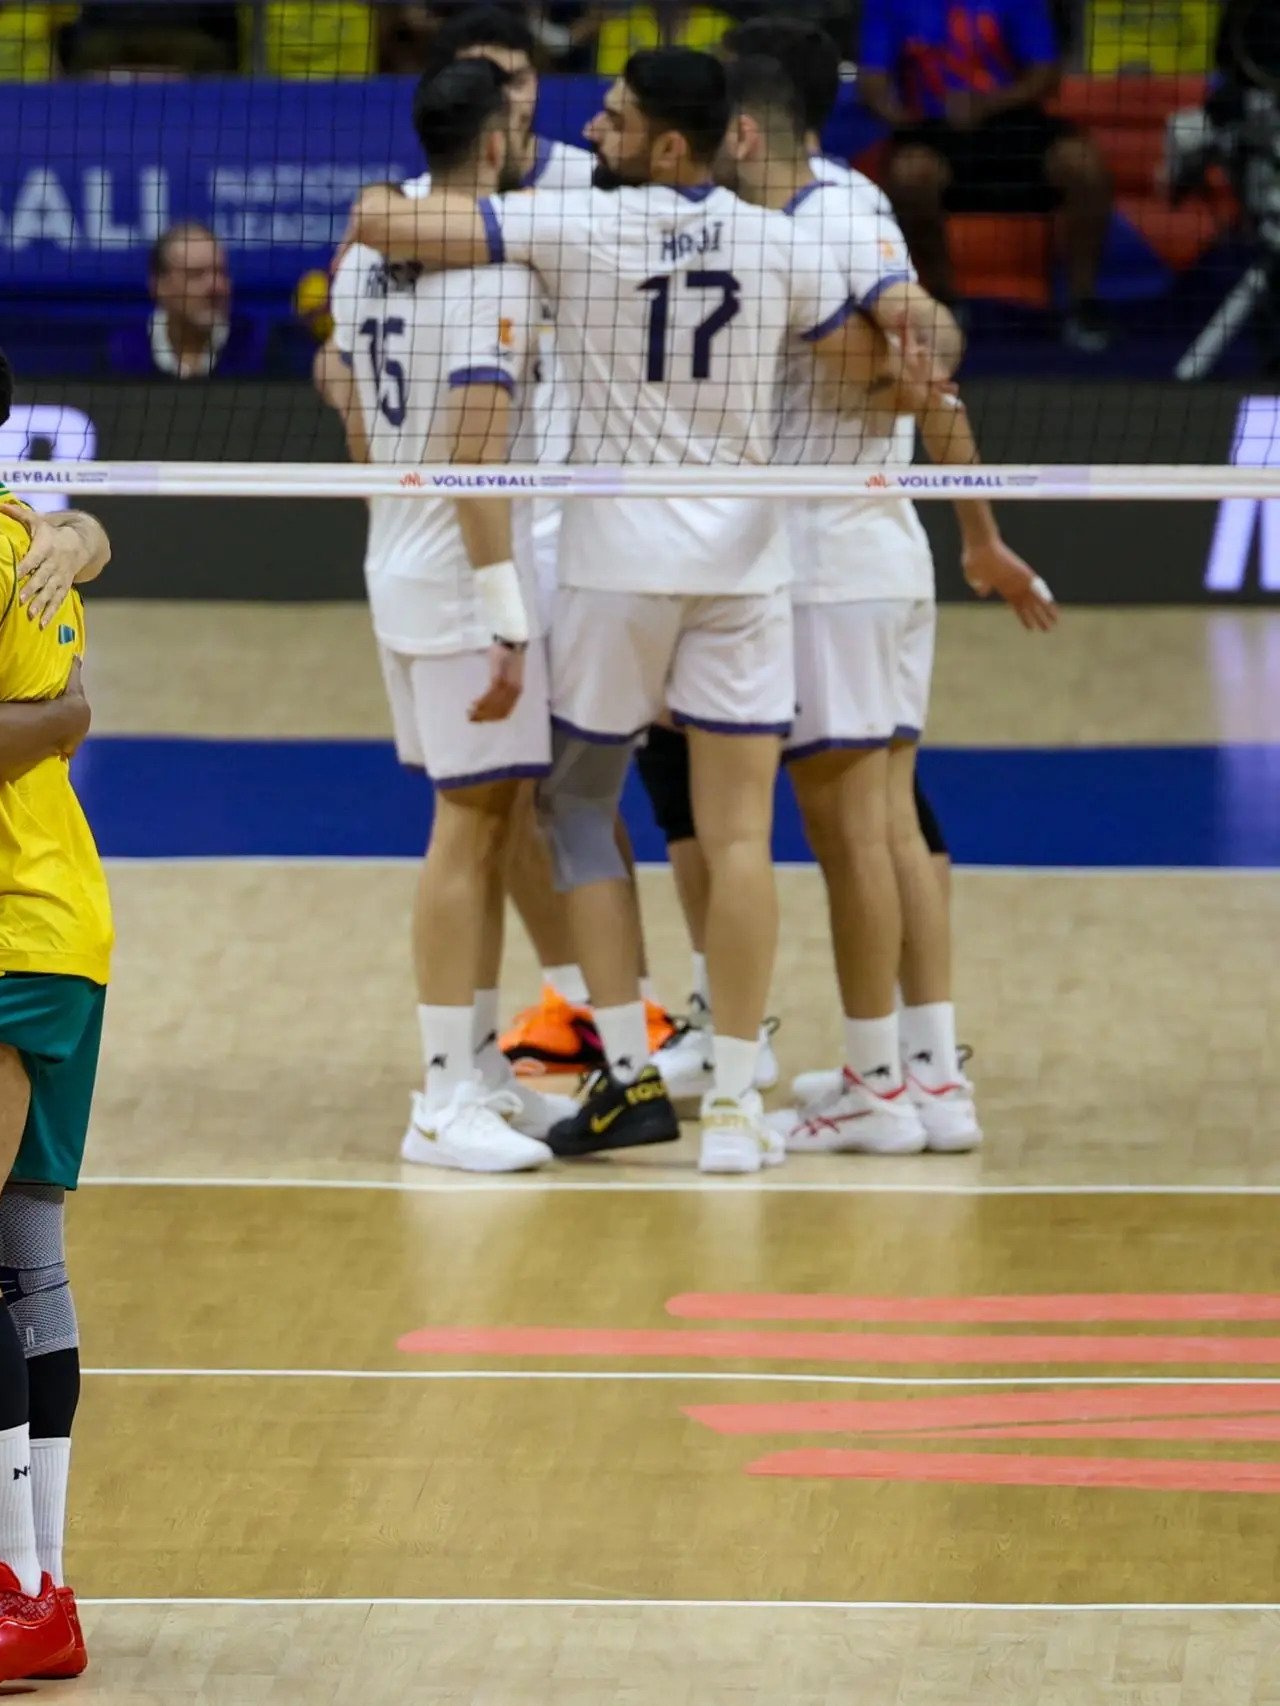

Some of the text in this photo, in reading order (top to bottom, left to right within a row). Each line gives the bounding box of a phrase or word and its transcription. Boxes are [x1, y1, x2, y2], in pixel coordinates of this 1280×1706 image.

[637, 270, 740, 382] 17
[359, 316, 405, 426] 15
[432, 475, 537, 487] VOLLEYBALL
[898, 475, 1003, 488] VOLLEYBALL
